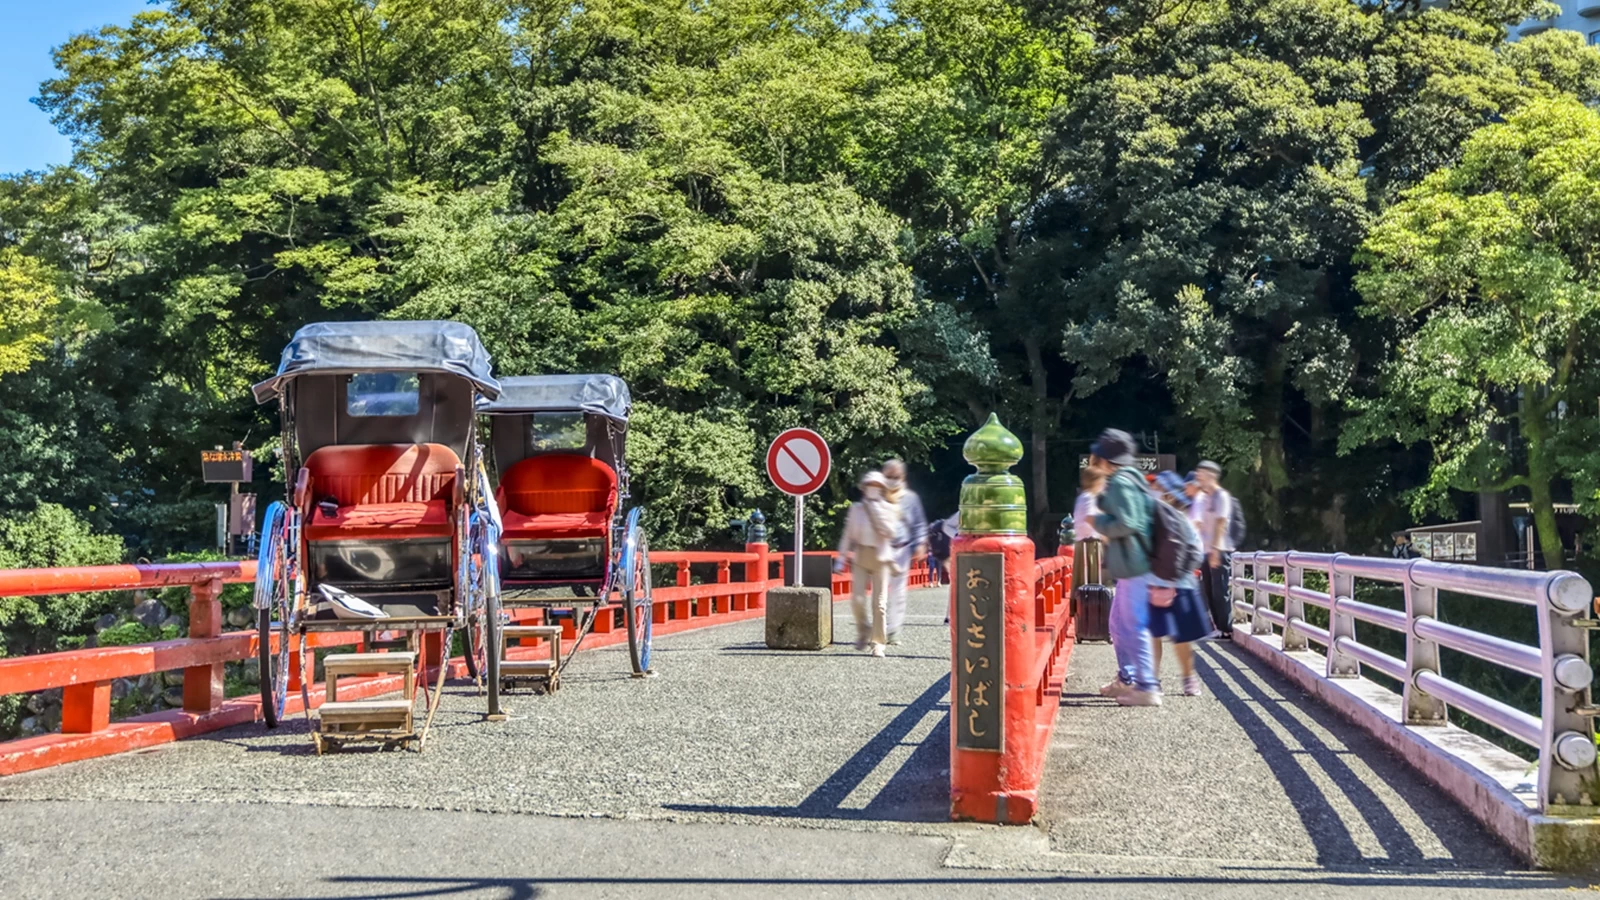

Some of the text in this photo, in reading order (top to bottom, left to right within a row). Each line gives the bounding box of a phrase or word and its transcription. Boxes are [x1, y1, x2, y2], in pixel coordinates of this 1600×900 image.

[964, 568, 993, 738] あじさいばし
